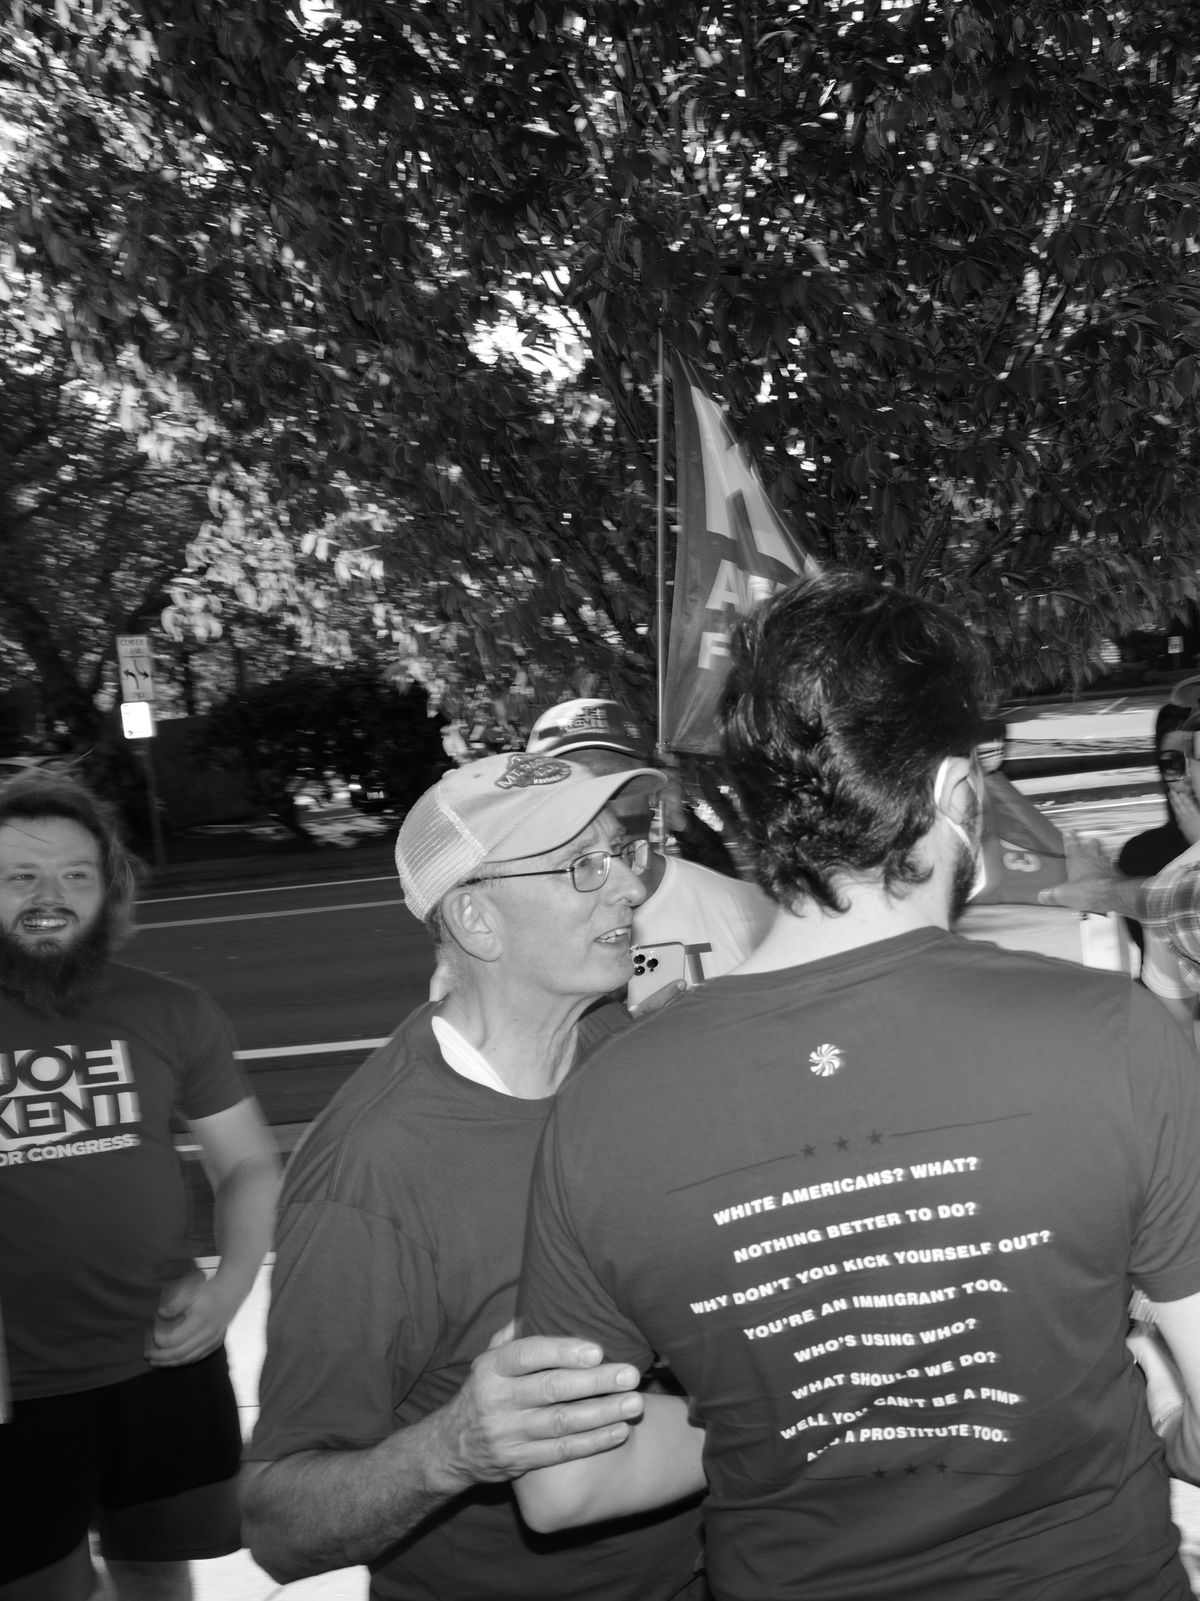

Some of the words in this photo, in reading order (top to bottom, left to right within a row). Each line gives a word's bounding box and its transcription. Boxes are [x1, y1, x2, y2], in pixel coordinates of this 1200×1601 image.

[27, 1133, 139, 1162] CONGRESS
[714, 1196, 777, 1226] WHITE
[781, 1168, 905, 1206] AMERICANS?
[910, 1157, 980, 1179] WHAT?
[733, 1229, 823, 1263] NOTHING
[826, 1212, 902, 1239] BETTER
[905, 1208, 933, 1222] TO
[937, 1202, 978, 1219] DO?
[690, 1295, 728, 1314] WHY
[733, 1277, 791, 1305] DON'T
[796, 1264, 838, 1284] YOU
[842, 1254, 891, 1272] KICK
[894, 1242, 993, 1264] YOURSELF
[998, 1230, 1052, 1252] OUT?
[743, 1309, 817, 1340] YOU'RE
[821, 1299, 849, 1316] AN
[852, 1287, 958, 1308] IMMIGRANT
[962, 1279, 1009, 1294] TOO.
[793, 1335, 857, 1362] WHO'S
[861, 1333, 916, 1346] USING
[920, 1318, 977, 1344] WHO?
[792, 1374, 846, 1399] WHAT
[850, 1369, 920, 1386] SHOULD
[925, 1361, 955, 1377] WE
[959, 1351, 997, 1367] DO?
[780, 1413, 829, 1439] WELL
[873, 1395, 925, 1408] CAN'T
[932, 1393, 957, 1407] BE
[963, 1388, 976, 1400] A
[980, 1387, 1021, 1405] PIMP
[845, 1430, 856, 1443] A
[859, 1424, 969, 1442] PROSTITUTE
[973, 1424, 1009, 1442] TOO.
